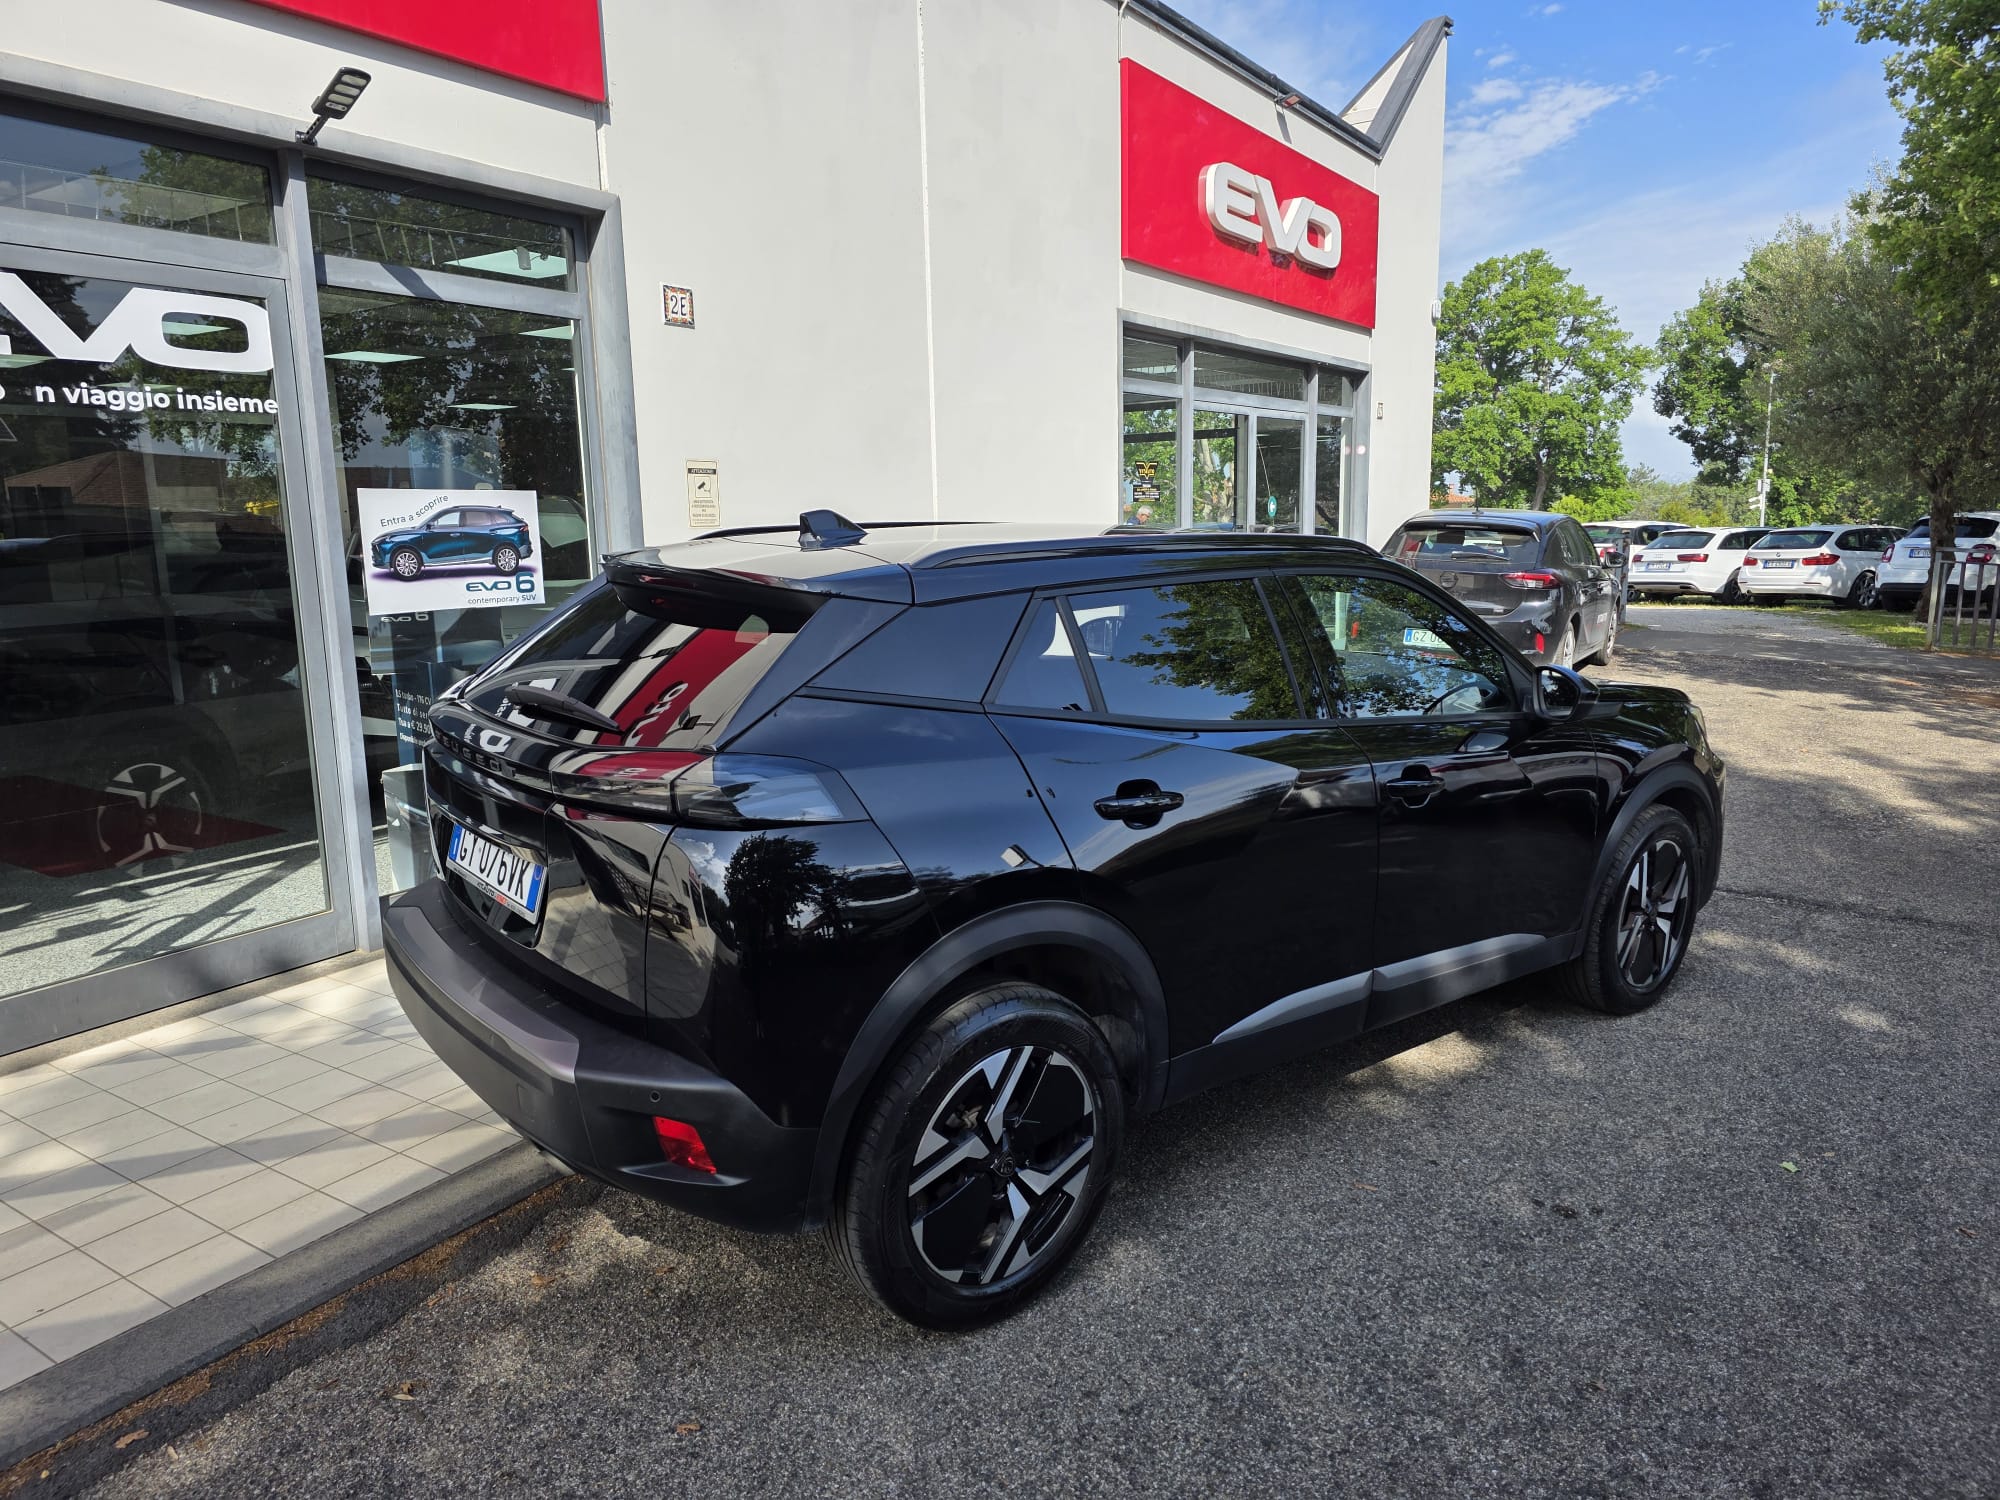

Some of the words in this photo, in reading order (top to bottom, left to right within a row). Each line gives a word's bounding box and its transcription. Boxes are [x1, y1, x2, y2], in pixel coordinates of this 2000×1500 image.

[1199, 161, 1342, 269] EVO
[670, 294, 687, 316] 2E
[62, 382, 171, 412] viaggio
[177, 387, 279, 414] insieme
[380, 516, 406, 528] Entra
[408, 514, 414, 522] a
[415, 495, 449, 518] scoprire
[465, 580, 512, 592] EVO
[515, 571, 536, 594] 6
[467, 596, 520, 605] contemporary
[521, 593, 537, 601] SUV
[415, 611, 430, 622] 6
